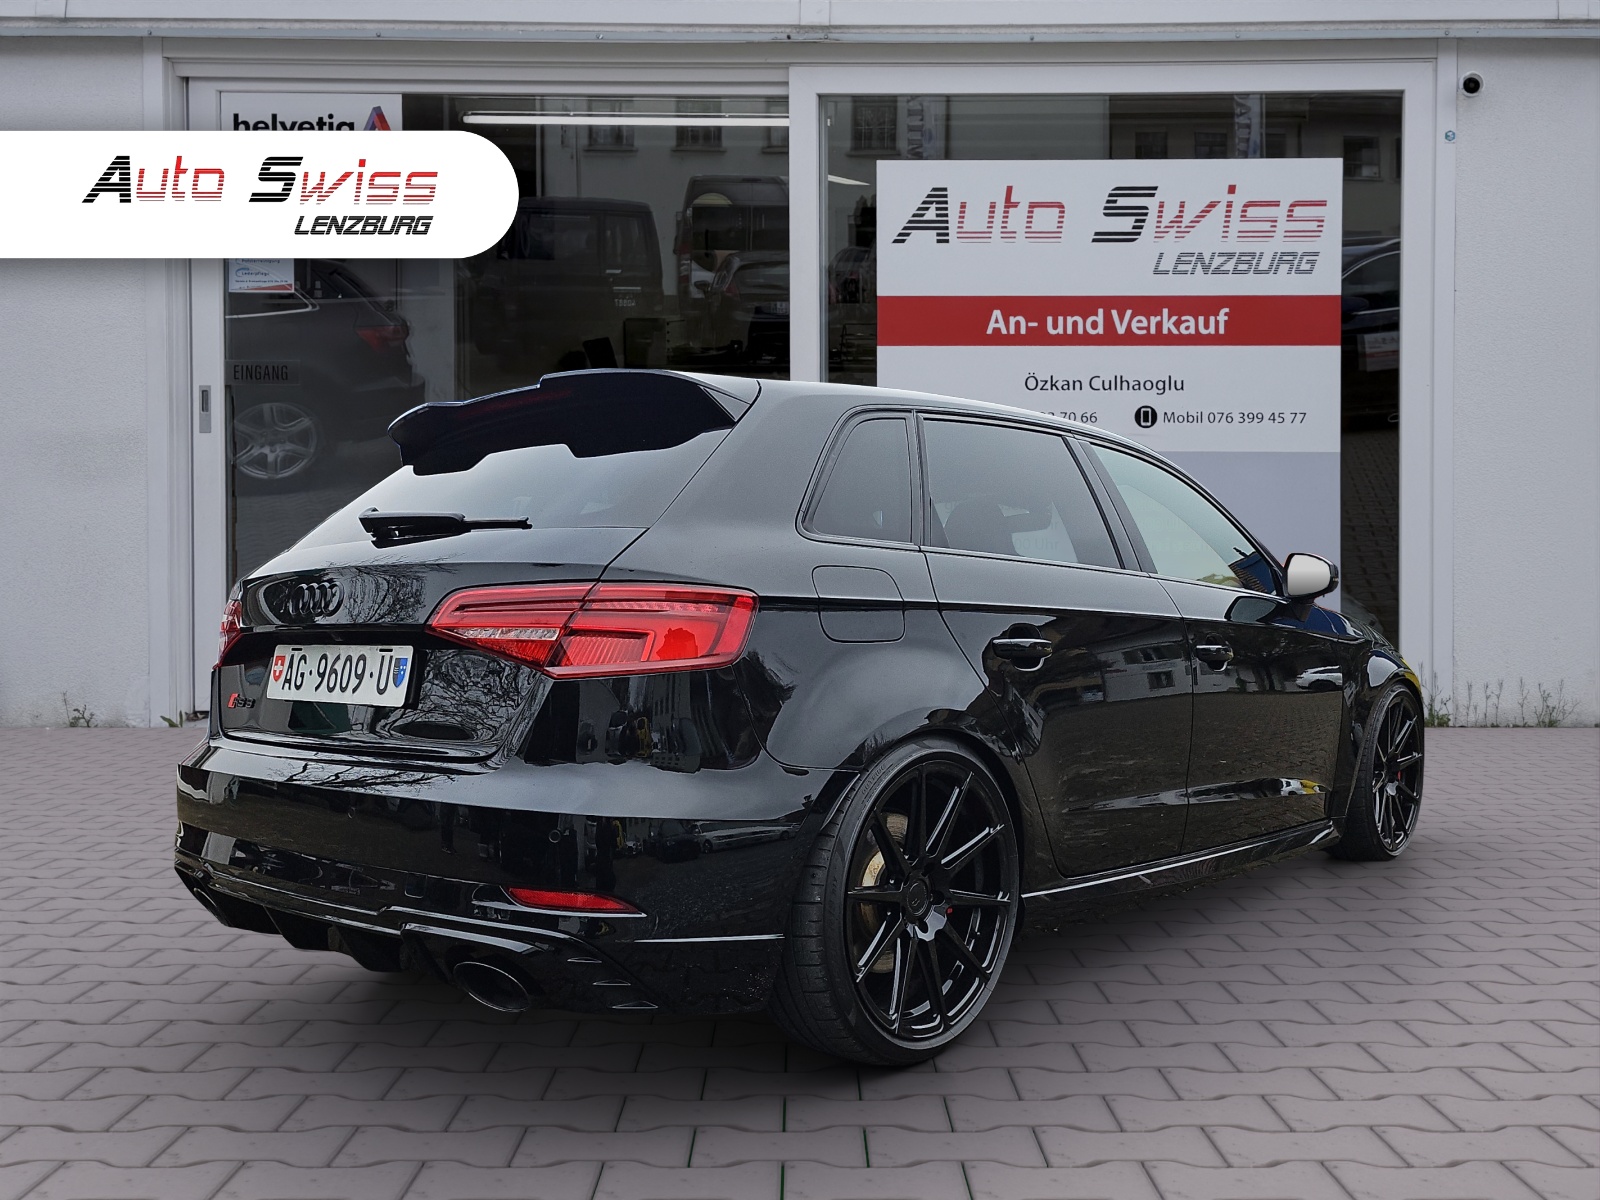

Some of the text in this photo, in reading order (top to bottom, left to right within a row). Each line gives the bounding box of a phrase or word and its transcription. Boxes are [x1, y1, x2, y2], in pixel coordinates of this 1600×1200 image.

[232, 112, 355, 131] helvetia
[891, 184, 1328, 244] Auto Swiss
[1152, 251, 1320, 275] LENZBURG
[986, 308, 1230, 335] An- und Verkauf
[233, 364, 289, 381] EINGANG
[1024, 372, 1185, 395] Özkan Culhaoglu
[1080, 411, 1098, 424] 66
[1163, 411, 1307, 424] Mobil 076 399 45 77
